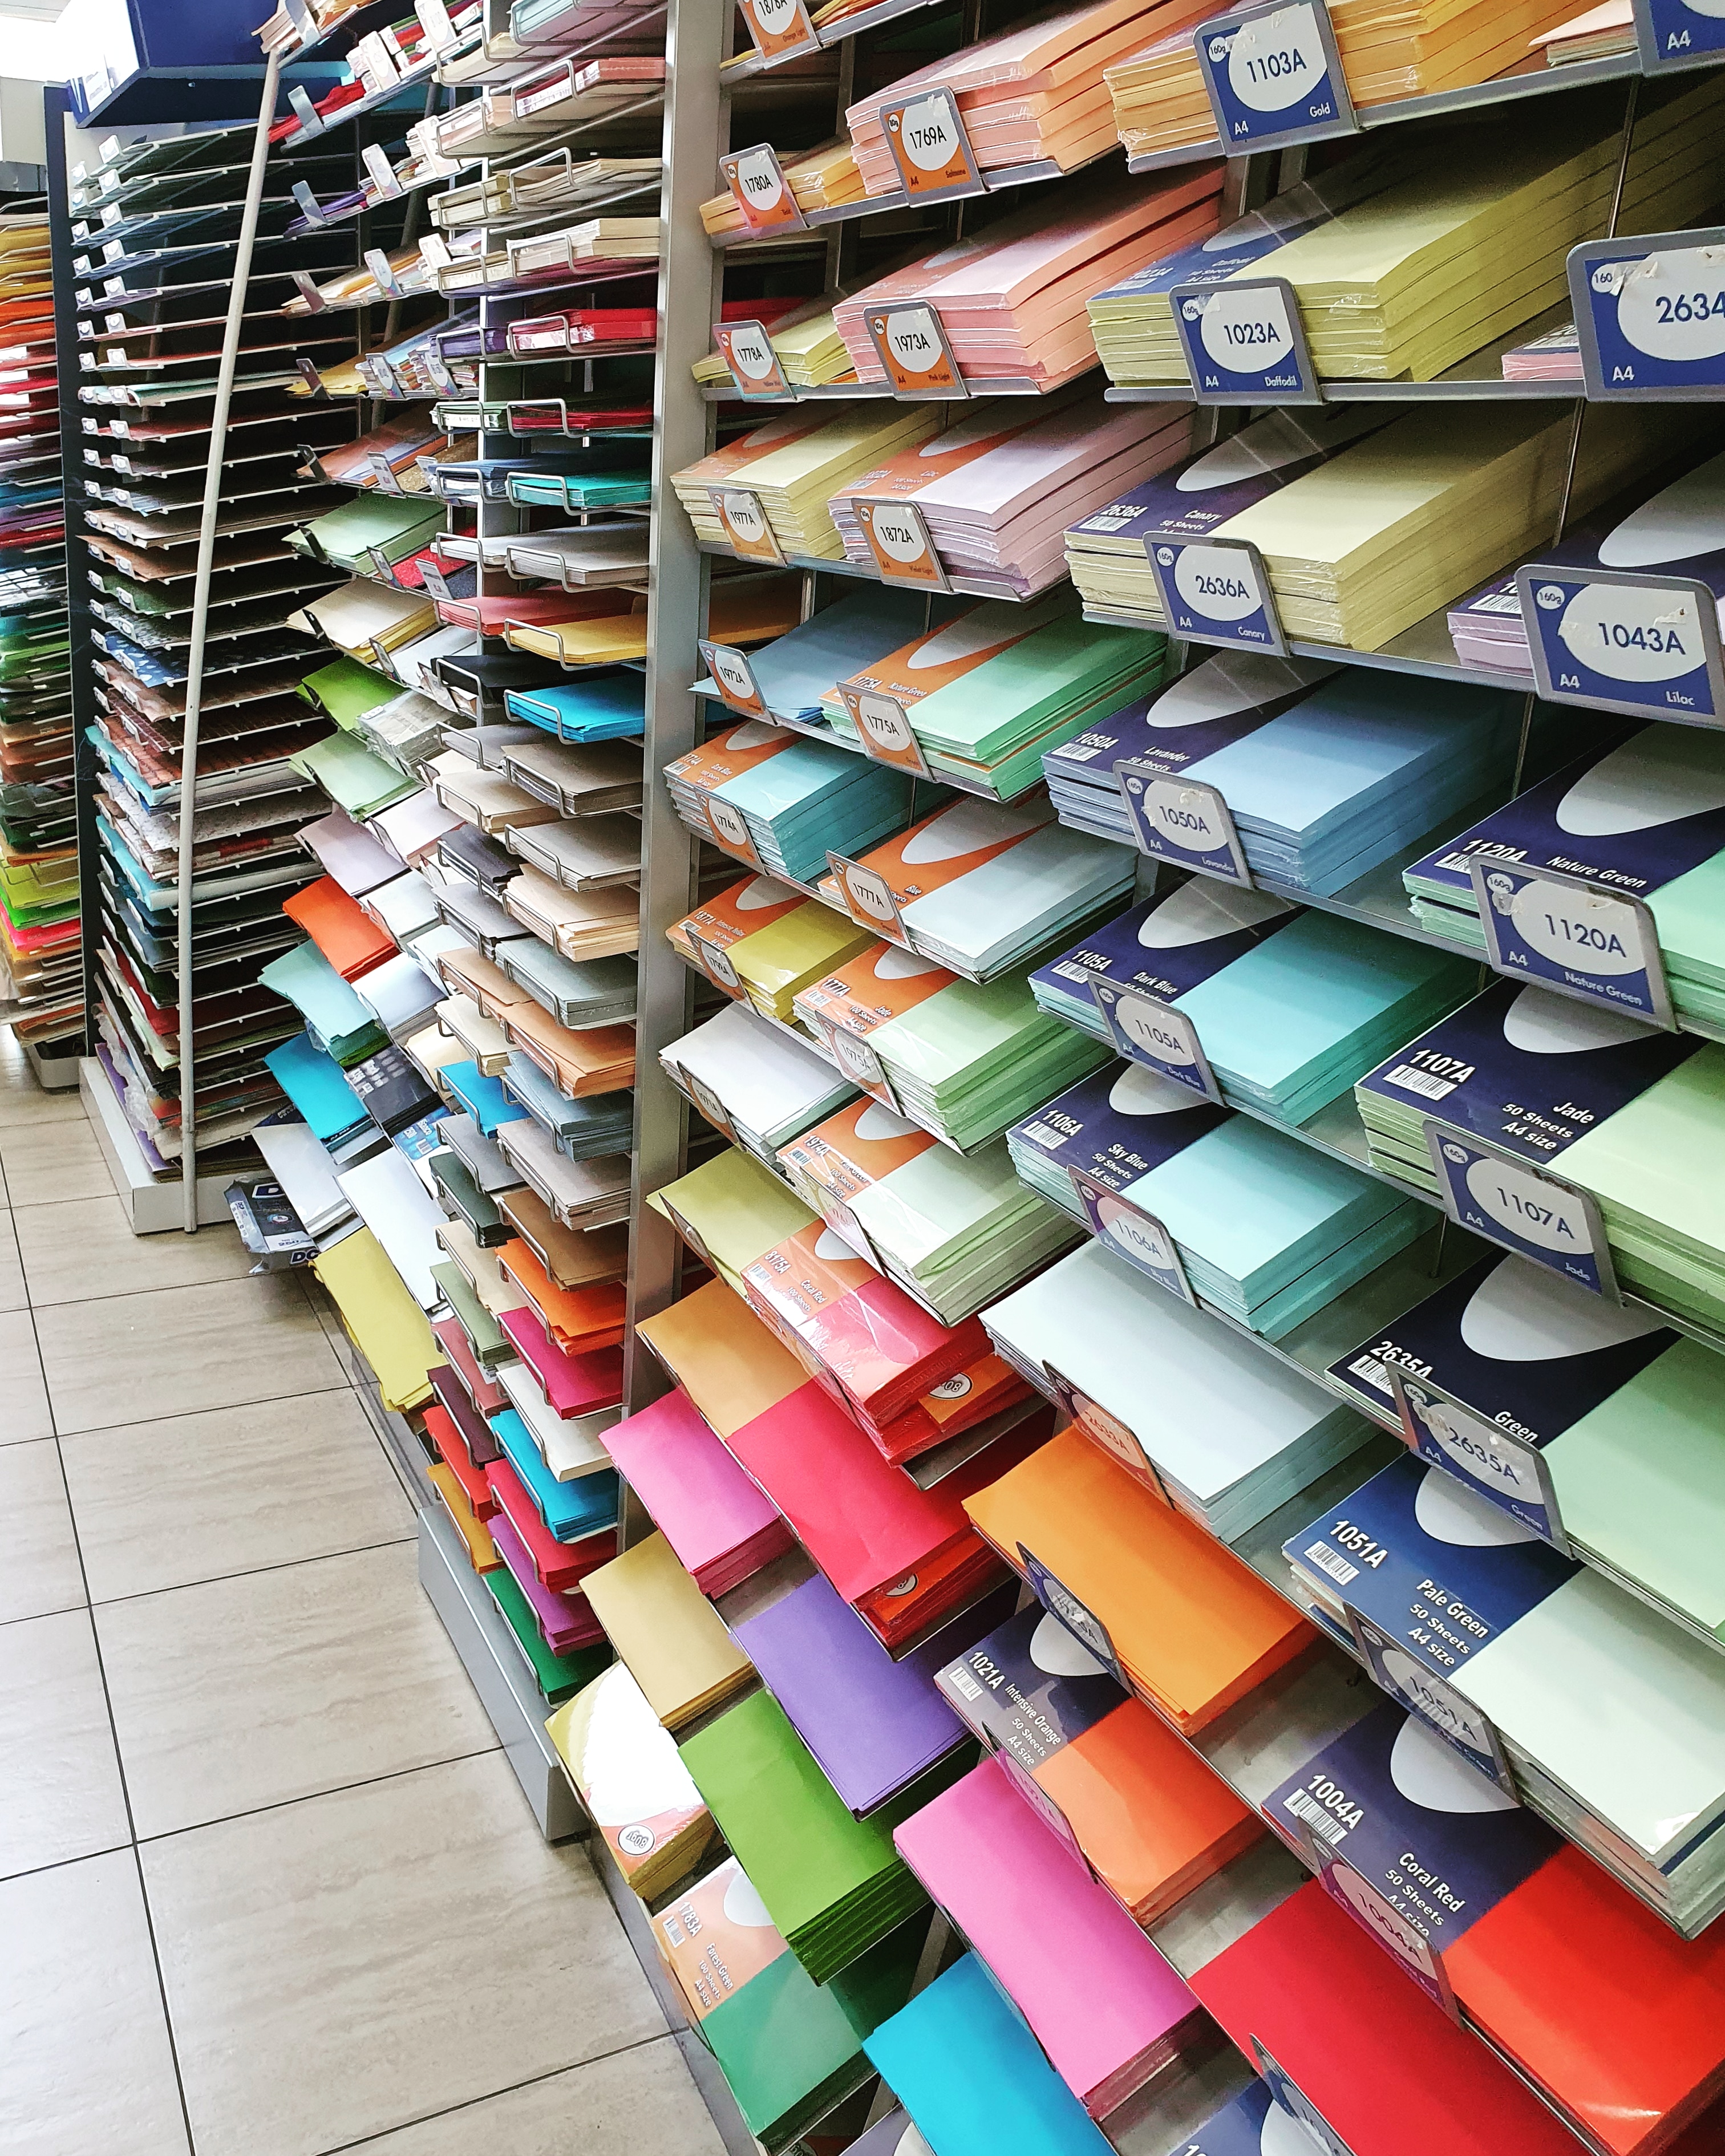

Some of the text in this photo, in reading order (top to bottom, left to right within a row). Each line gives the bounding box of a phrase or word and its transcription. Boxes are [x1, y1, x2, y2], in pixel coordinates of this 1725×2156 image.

[1667, 30, 1691, 50] A4
[1247, 48, 1307, 83] 1103A
[1310, 102, 1331, 118] Gold
[909, 125, 947, 149] 1769A
[1234, 120, 1249, 135] A4
[744, 174, 774, 193] 1780A
[910, 176, 919, 187] A4
[1594, 273, 1613, 283] 160
[894, 333, 931, 352] 1973A
[1224, 322, 1281, 345] 1023A
[738, 346, 764, 363] 1778A
[897, 375, 906, 385] A4
[1205, 375, 1219, 387] A4
[1265, 375, 1297, 387] Daffodil
[1613, 366, 1635, 382] A4
[730, 511, 757, 526] 1977A
[1100, 505, 1148, 517] 2636A
[1184, 510, 1222, 522] Canary
[880, 526, 914, 544] 1872A
[1173, 520, 1205, 531] Sheets
[1195, 575, 1250, 599] 2636A
[1539, 591, 1562, 605] 160g
[1179, 616, 1192, 628] A4
[1237, 626, 1266, 641] Canary
[1598, 622, 1686, 655] 1043A
[720, 666, 746, 685] 1972A
[852, 676, 883, 689] 1775A
[1560, 674, 1580, 688] A4
[1666, 691, 1695, 706] Lilac
[866, 715, 900, 736] 1775A
[1075, 732, 1119, 750] 1050A
[1140, 760, 1172, 772] Sheets
[1144, 747, 1190, 763] Lavander
[714, 813, 739, 833] 1774A
[1160, 805, 1210, 834] 1050A
[1150, 839, 1163, 852] A4
[1462, 840, 1529, 862] 1120A
[1546, 856, 1647, 889] Nature Green
[853, 882, 884, 908] 1777A
[694, 910, 716, 926] 1877A
[1545, 914, 1627, 958] 1120A
[1071, 950, 1113, 971] 1105A
[1509, 950, 1528, 966] A4
[822, 978, 851, 997] 1777A
[1133, 972, 1157, 986] Dark
[1153, 980, 1177, 994] Blue
[1565, 971, 1643, 1006] Nature Green
[859, 1011, 878, 1025] Sheets
[874, 1006, 892, 1017] Jade
[1135, 1019, 1185, 1054] 1105A
[1123, 1043, 1134, 1055] A4
[1410, 1049, 1476, 1083] 1107A
[1042, 1109, 1084, 1137] 1106A
[1502, 1103, 1574, 1139] 50 Sheets
[1553, 1102, 1596, 1124] Jade
[804, 1135, 831, 1157] 1974A
[1501, 1121, 1558, 1151] A4 size
[1091, 1153, 1133, 1180] 50 Sheets
[1108, 1143, 1149, 1170] Sky Blue
[839, 1175, 856, 1191] Sheets
[1088, 1166, 1121, 1189] A4 size
[833, 1187, 846, 1197] size
[1465, 1211, 1484, 1227] A4
[1497, 1186, 1576, 1240] 1107A
[1115, 1219, 1163, 1259] 1106A
[765, 1250, 791, 1274] 8175A
[1565, 1262, 1590, 1282] Jade
[787, 1286, 812, 1312] 100 Sheets
[801, 1279, 828, 1304] Coral Red
[1370, 1340, 1434, 1378] 2635A
[941, 1380, 962, 1392] 80
[1495, 1411, 1538, 1443] Green
[1426, 1446, 1442, 1464] A4
[1448, 1428, 1520, 1486] 2635A
[1511, 1504, 1544, 1531] Green
[1329, 1519, 1388, 1570] 1051A
[1416, 1578, 1489, 1640] Pale Green
[1410, 1603, 1471, 1655] 50 Sheets
[1407, 1626, 1456, 1668] A4 size
[968, 1650, 1007, 1691] 1021A
[1005, 1683, 1062, 1746] Intensive Orange
[1410, 1675, 1479, 1743] 1051A
[1011, 1717, 1047, 1758] 50 Sheets
[1006, 1735, 1035, 1766] A4 size
[1307, 1774, 1365, 1830] 1004A
[1399, 1853, 1466, 1914] Coral Red
[1384, 1869, 1445, 1927] 50 Sheets
[678, 1901, 703, 1937] 1783A
[1358, 1892, 1423, 1964] 1004A
[706, 1942, 734, 1990] Forest Green
[699, 1960, 720, 1999] 100 Sheets
[695, 1979, 712, 2008] A4 size
